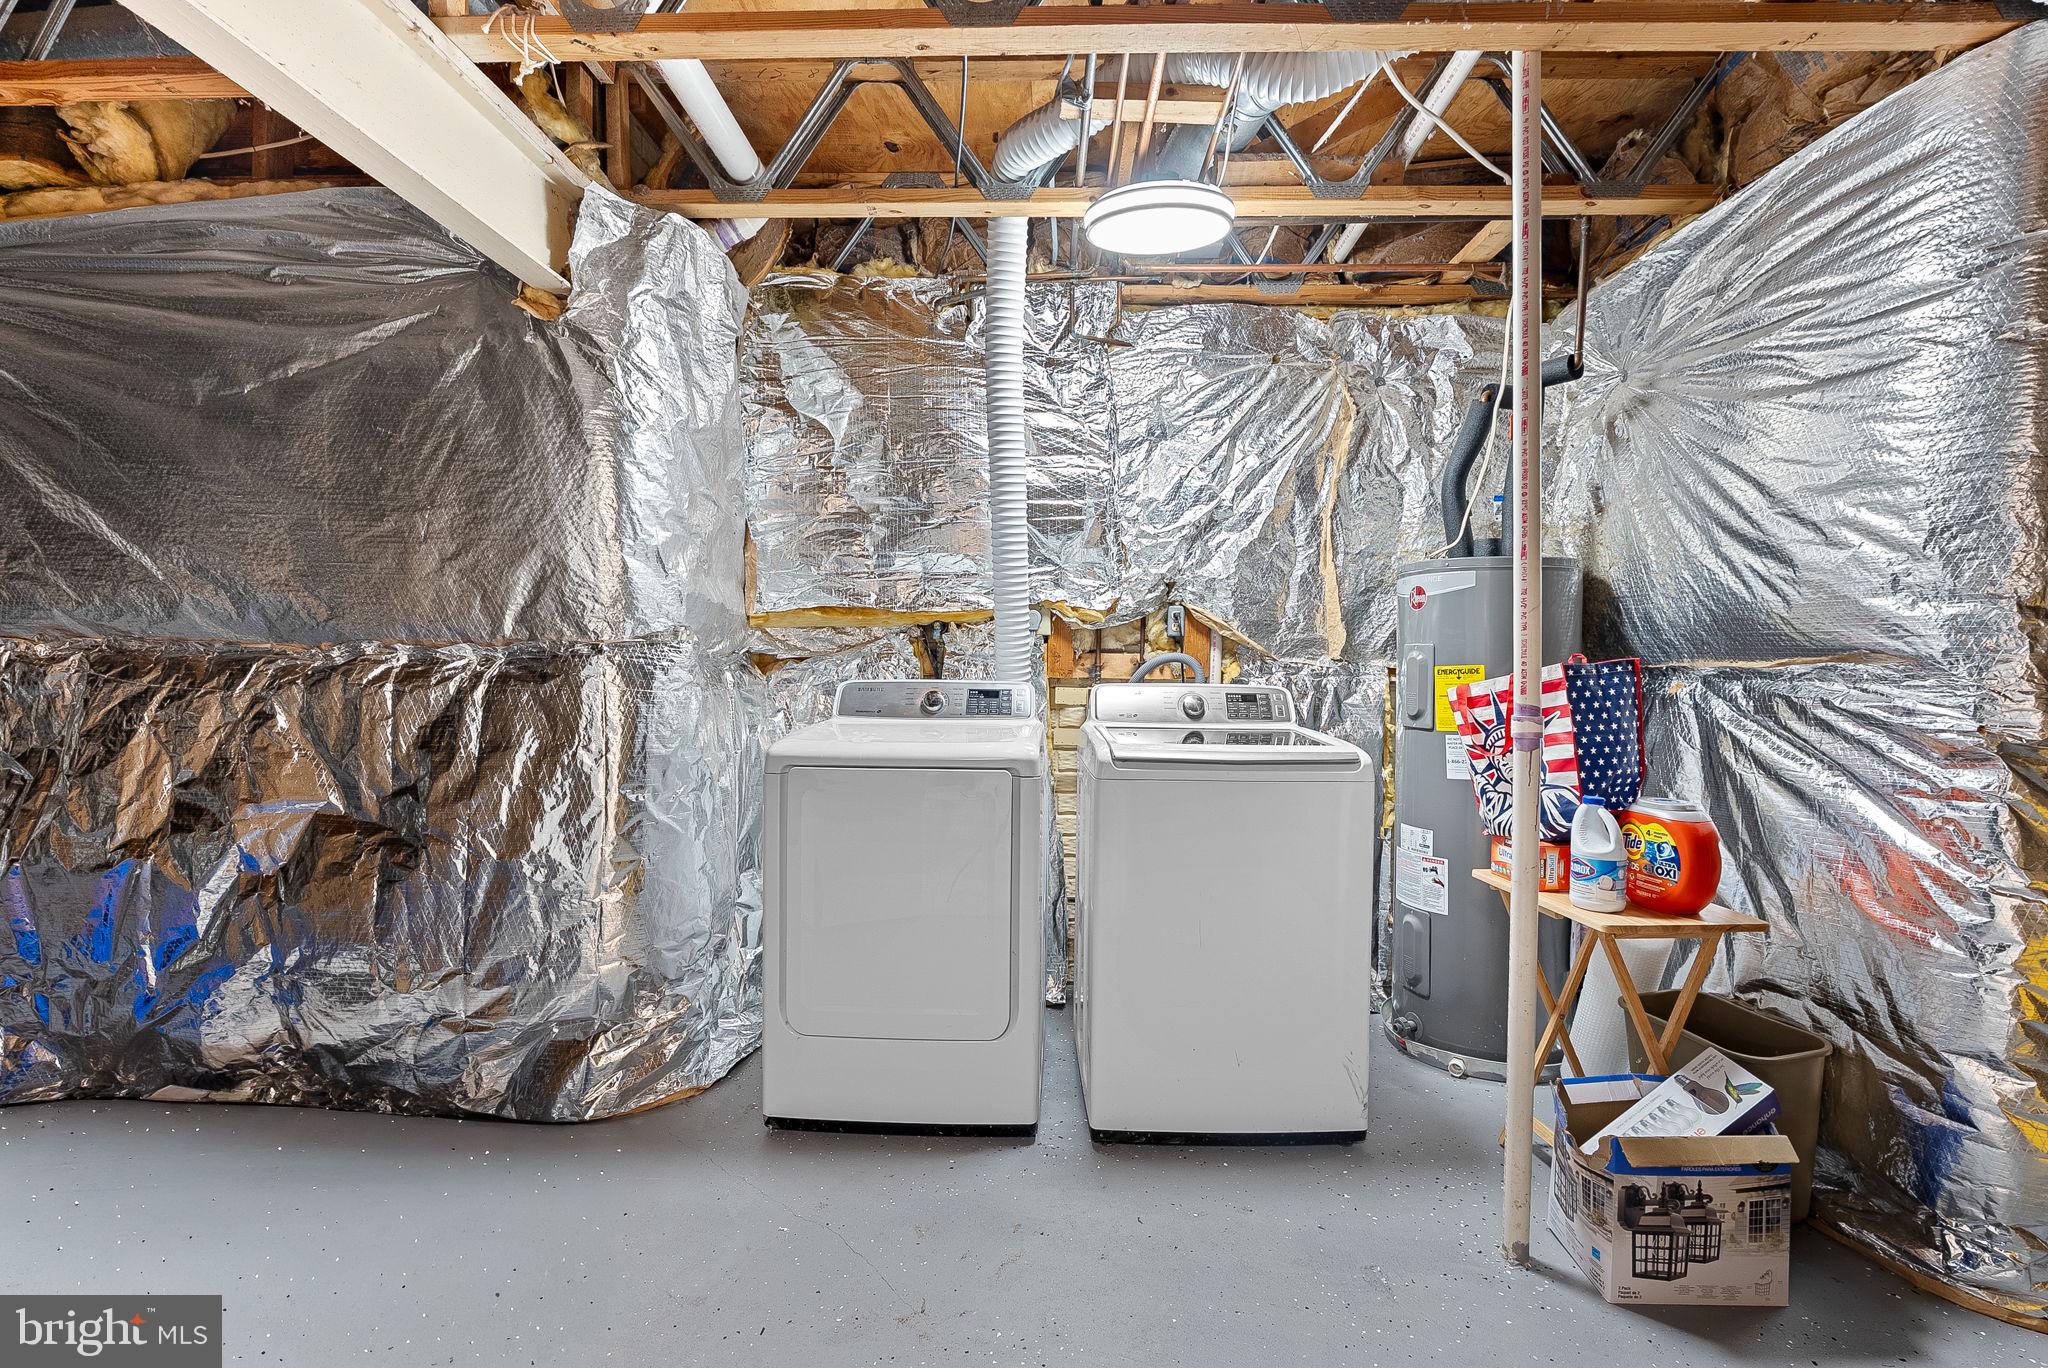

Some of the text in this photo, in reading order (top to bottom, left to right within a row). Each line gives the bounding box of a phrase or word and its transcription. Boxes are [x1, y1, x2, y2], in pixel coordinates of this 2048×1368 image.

[1437, 667, 1481, 676] ENERGYGUIDE
[1622, 832, 1643, 849] Tide
[1547, 854, 1555, 884] UltraSoft
[1655, 866, 1677, 880] OXI
